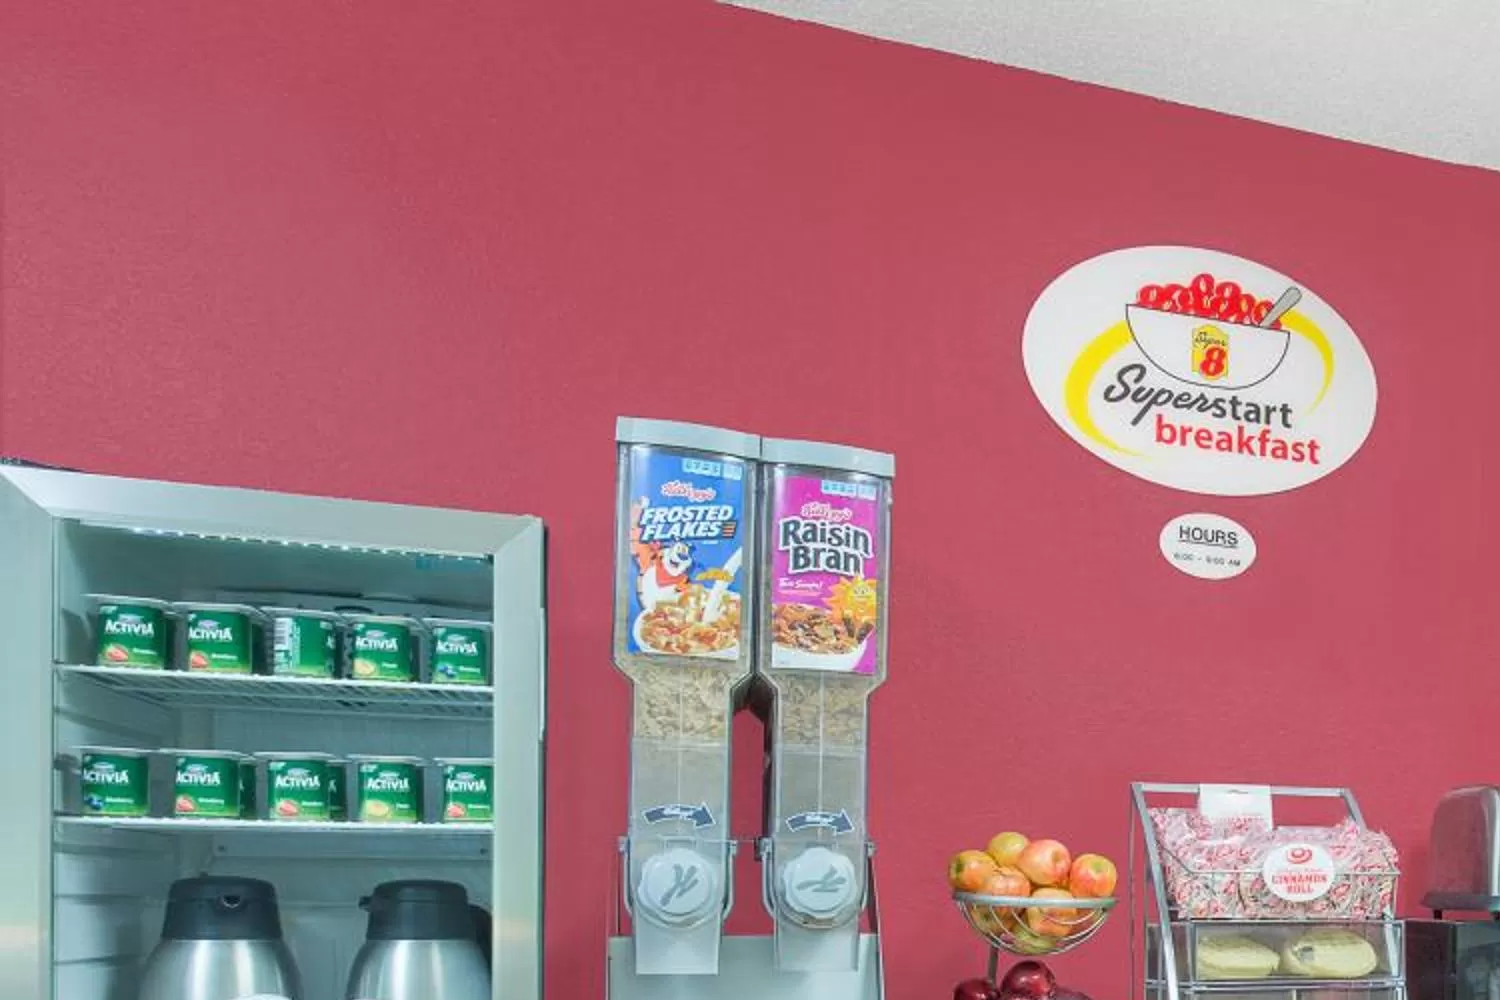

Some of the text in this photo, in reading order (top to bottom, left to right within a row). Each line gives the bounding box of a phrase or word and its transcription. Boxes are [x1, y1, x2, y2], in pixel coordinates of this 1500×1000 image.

[1200, 345, 1227, 377] 8
[1103, 363, 1293, 428] Superstart
[1154, 413, 1321, 465] breakfast
[640, 504, 734, 527] FROSTED
[640, 520, 722, 542] FLAKES
[780, 517, 873, 557] Raisin
[1178, 525, 1239, 546] HOURS
[789, 545, 864, 577] Bran
[104, 619, 155, 638] ACTIVIA
[187, 627, 233, 641] ACTIVIA
[355, 635, 399, 651] ACTIVIA
[435, 641, 478, 657] ACTIVIA
[175, 771, 222, 786] ACTIVIA
[274, 775, 321, 791] ACTIVIA
[366, 776, 410, 793] ACTIVIA
[446, 778, 487, 793] ACTIVIA
